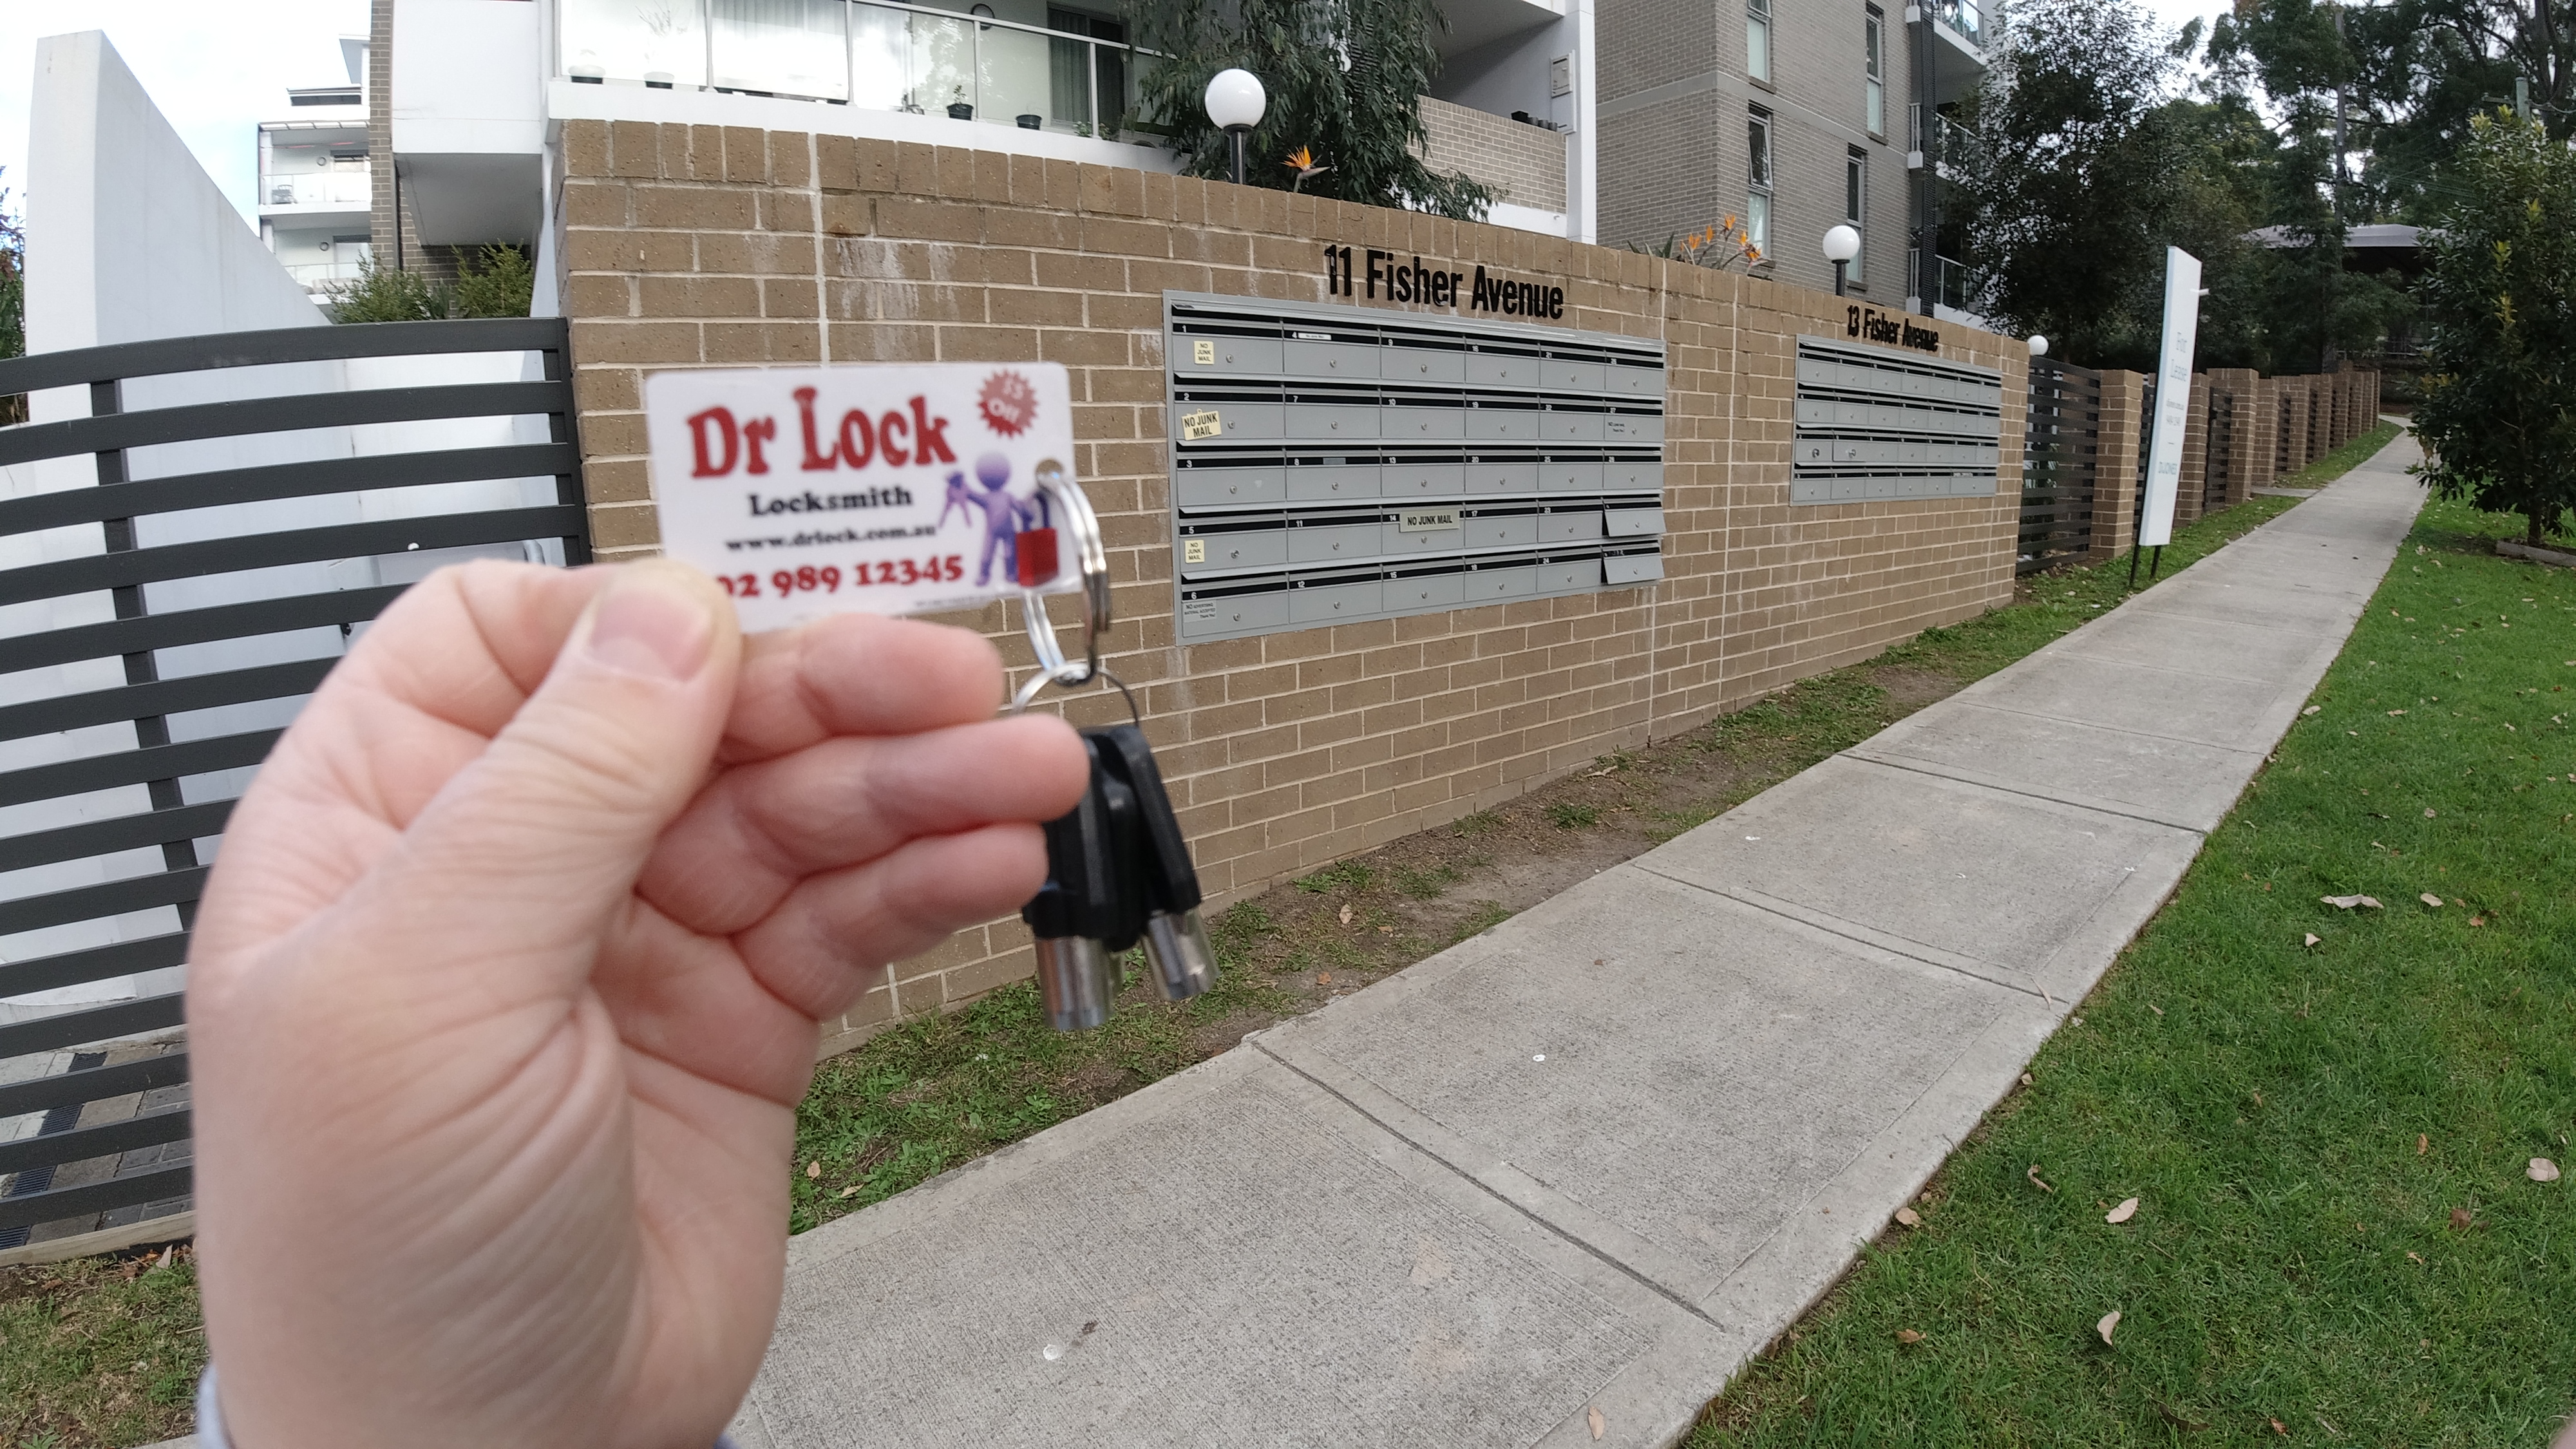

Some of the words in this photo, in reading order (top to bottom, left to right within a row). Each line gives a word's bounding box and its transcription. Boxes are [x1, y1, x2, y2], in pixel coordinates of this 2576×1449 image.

[1324, 244, 1352, 297] 11
[1367, 249, 1463, 307] Fisher
[1470, 265, 1564, 319] Avenue
[1182, 325, 1187, 333] 1
[1847, 305, 1860, 337] 13
[1863, 308, 1901, 344] Fisher
[1902, 317, 1939, 352] Avenue
[1184, 392, 1190, 401] 2
[1388, 398, 1396, 406] 10
[1184, 416, 1196, 429] NO
[1197, 412, 1218, 426] JUNK
[687, 406, 777, 477] Dr
[793, 386, 958, 471] Lock
[1193, 425, 1213, 438] MAIL
[1186, 459, 1192, 468] 3
[748, 486, 913, 516] Locksmith
[1407, 516, 1417, 526] NO
[1418, 515, 1437, 526] JUNK
[1437, 515, 1453, 524] MAIL
[726, 526, 936, 552] www.drlock.com.au
[773, 564, 841, 598] 989
[855, 554, 963, 588] 12345
